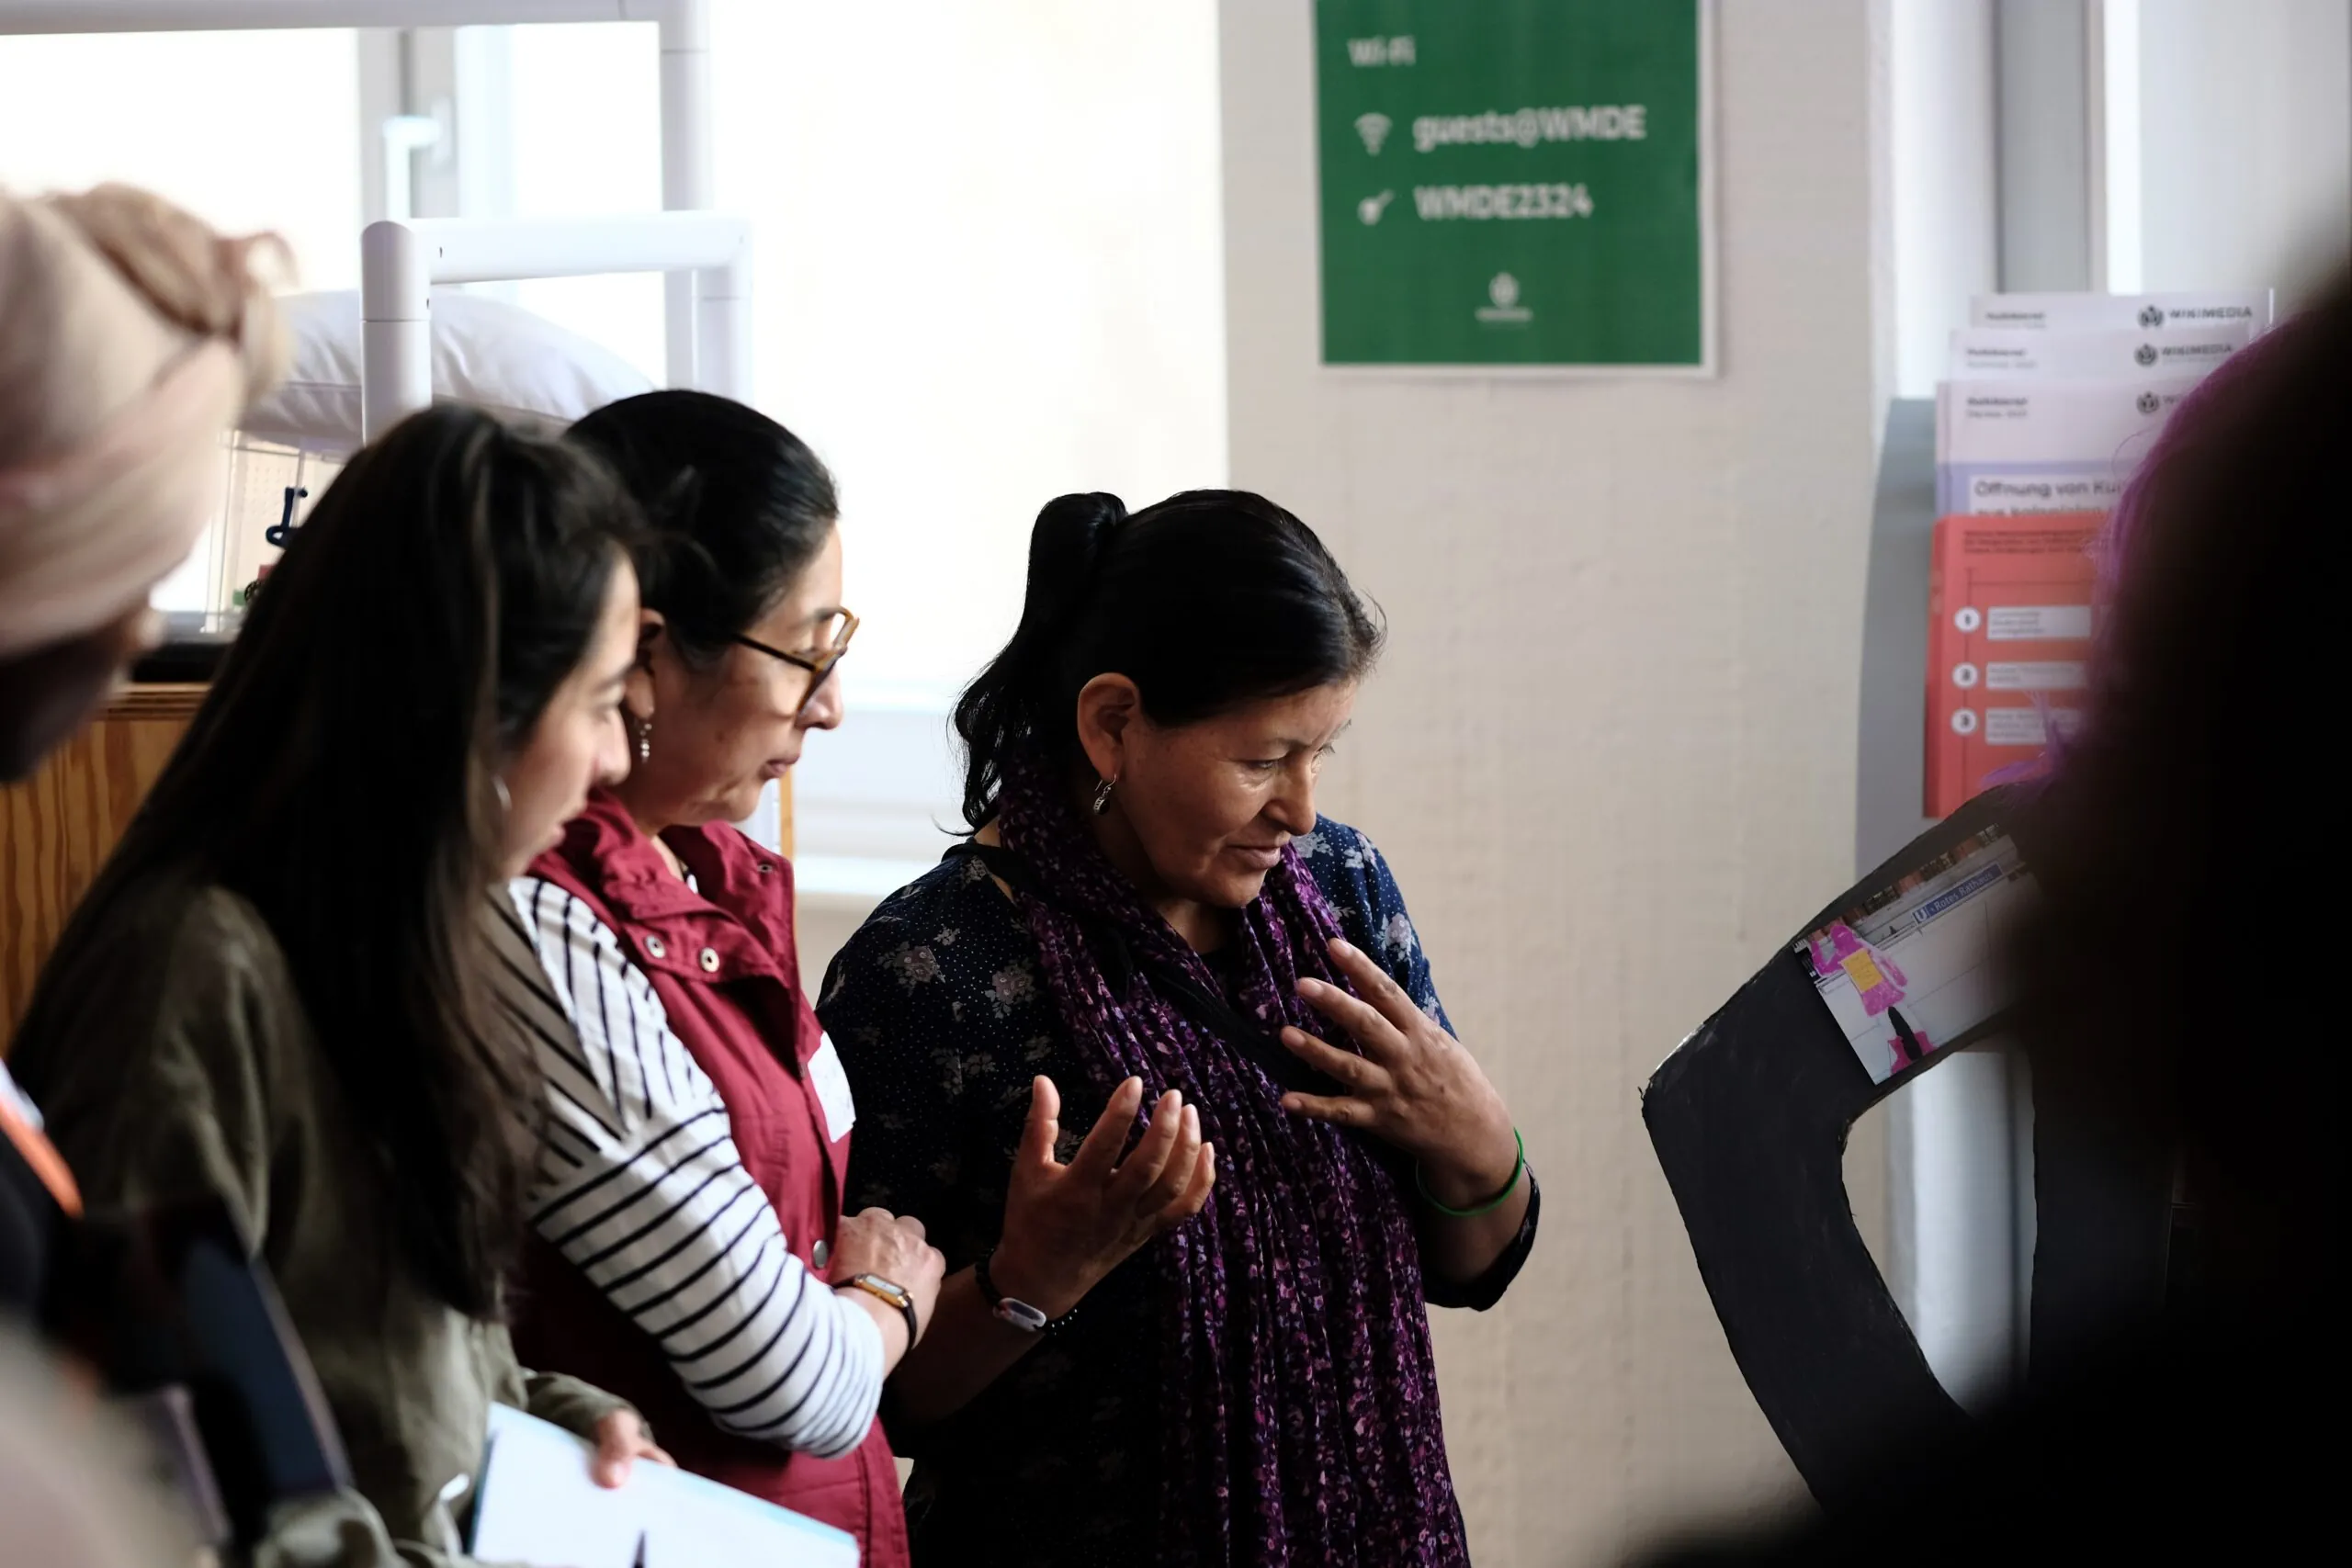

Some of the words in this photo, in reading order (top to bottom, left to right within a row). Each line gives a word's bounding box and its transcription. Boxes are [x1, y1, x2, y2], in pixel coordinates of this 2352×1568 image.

[1412, 104, 1647, 152] guests@WMDE
[1412, 183, 1594, 220] WMDE2324
[2168, 306, 2253, 319] WIKIMEDIA
[2162, 344, 2233, 356] WIKIMEDIA
[1934, 892, 1959, 911] Rotes
[1959, 872, 1994, 897] Rathaus
